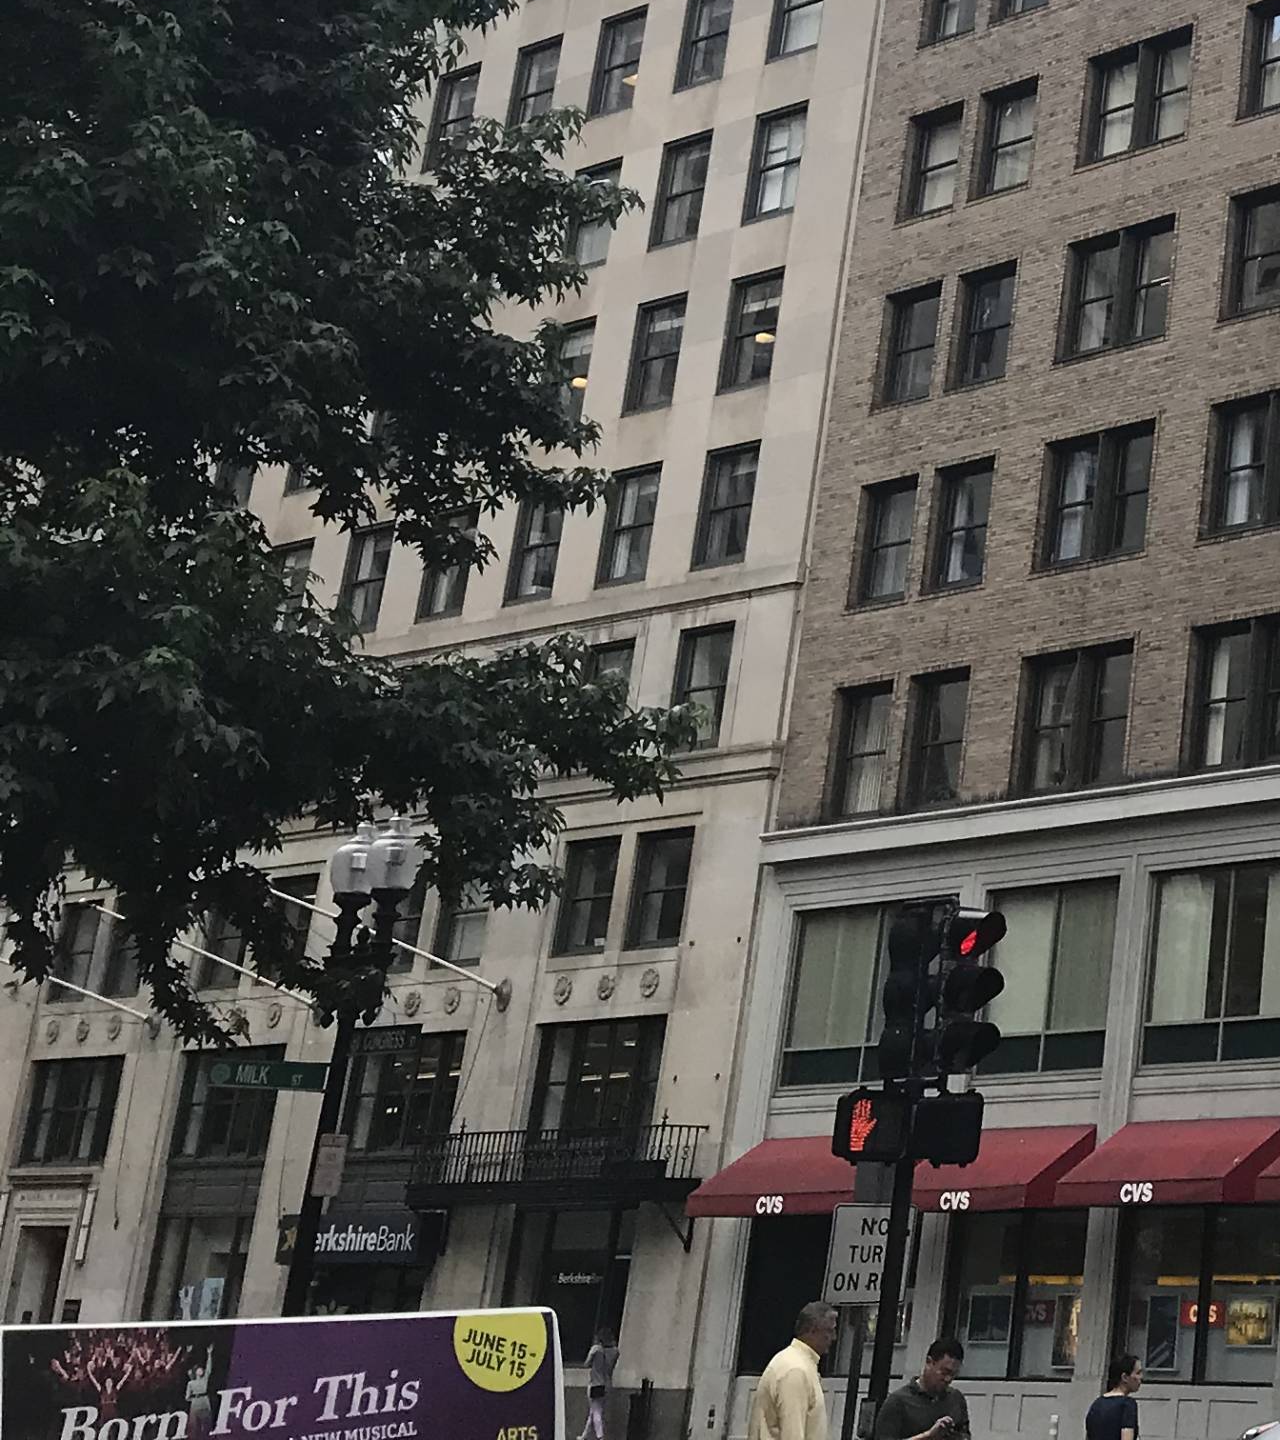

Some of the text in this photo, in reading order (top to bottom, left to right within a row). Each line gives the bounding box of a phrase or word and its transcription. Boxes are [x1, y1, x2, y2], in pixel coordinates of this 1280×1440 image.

[235, 1064, 271, 1085] MILK
[939, 1191, 970, 1210] CVS
[1119, 1182, 1154, 1203] CVS
[755, 1195, 784, 1214] CVS
[861, 1217, 890, 1236] NO
[314, 1224, 416, 1253] erkshireBank
[850, 1245, 884, 1264] TUR
[833, 1273, 859, 1292] ON
[1189, 1304, 1217, 1323] CS
[462, 1328, 507, 1354] JUNE
[465, 1348, 527, 1379] JULY 15
[60, 1368, 420, 1440] Born For This
[344, 1421, 417, 1440] MUSICAL
[496, 1425, 538, 1440] ARTS
